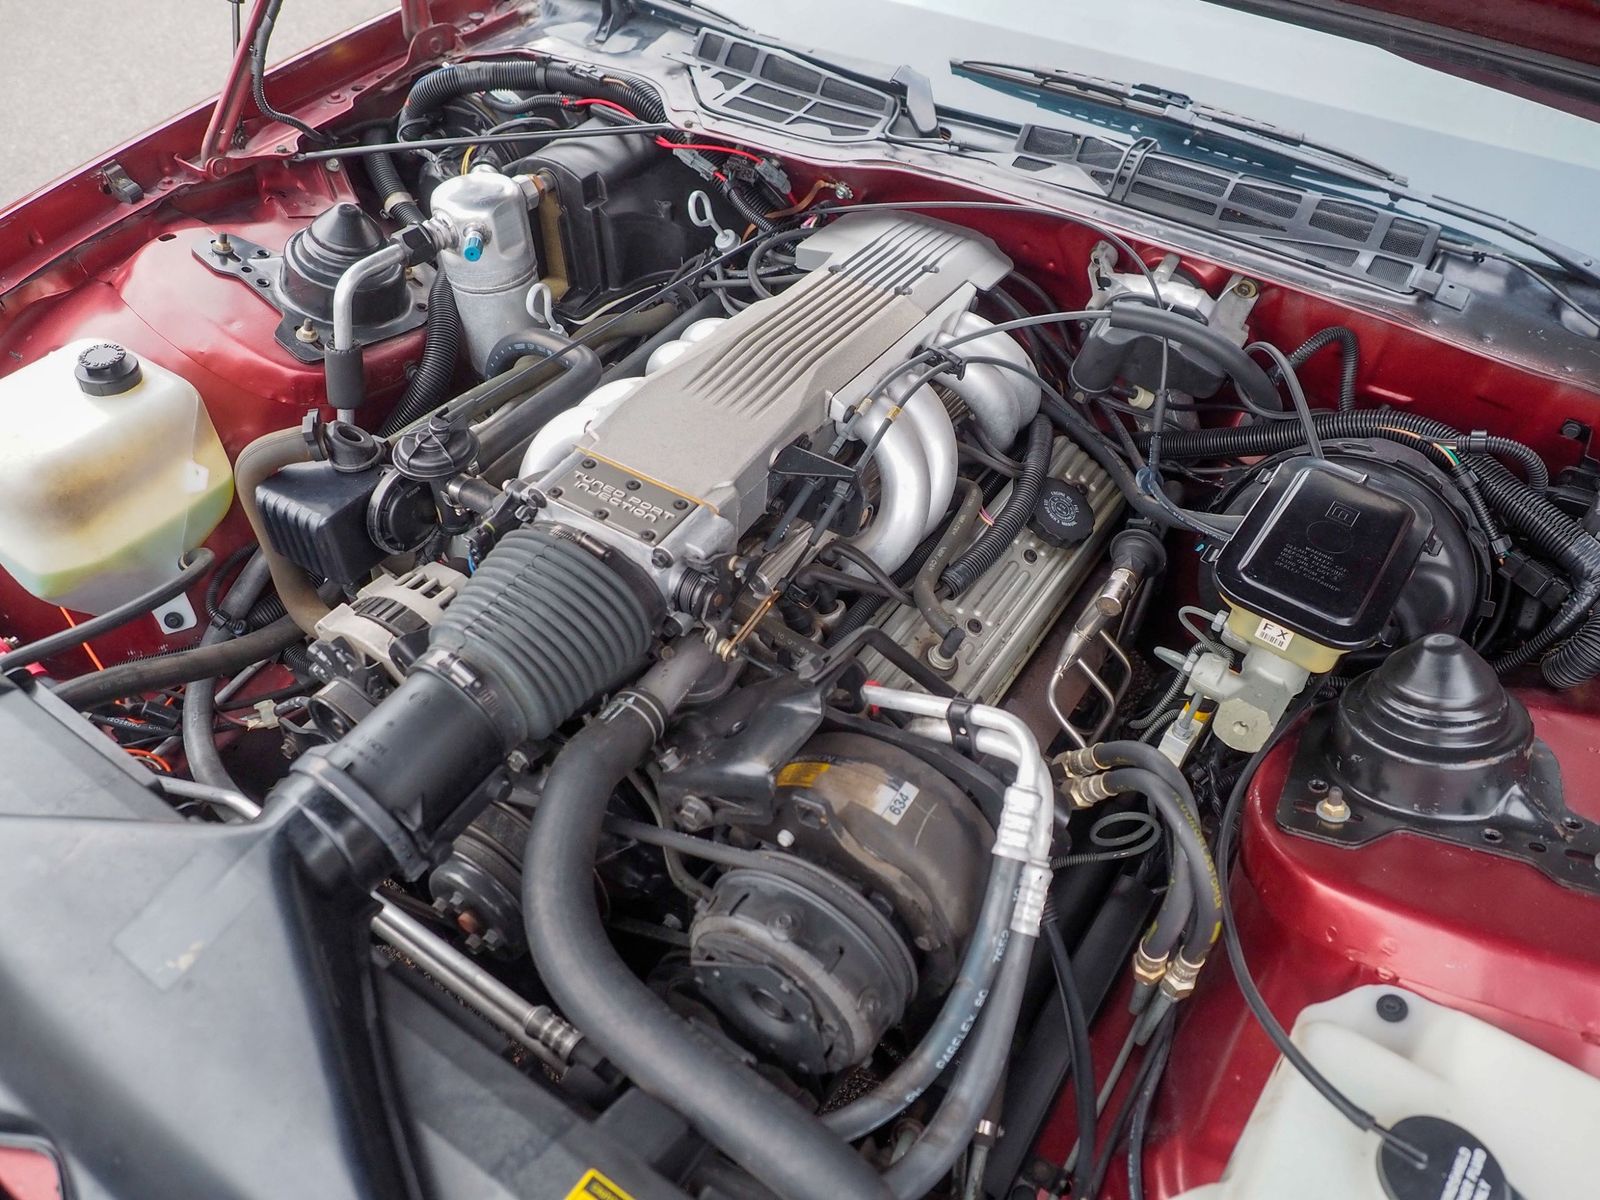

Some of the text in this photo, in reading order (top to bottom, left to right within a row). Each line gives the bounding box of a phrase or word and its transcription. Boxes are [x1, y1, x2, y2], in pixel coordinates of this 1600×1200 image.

[573, 480, 658, 524] INJECTION
[574, 470, 676, 520] TUNED PORT
[889, 792, 909, 816] 634
